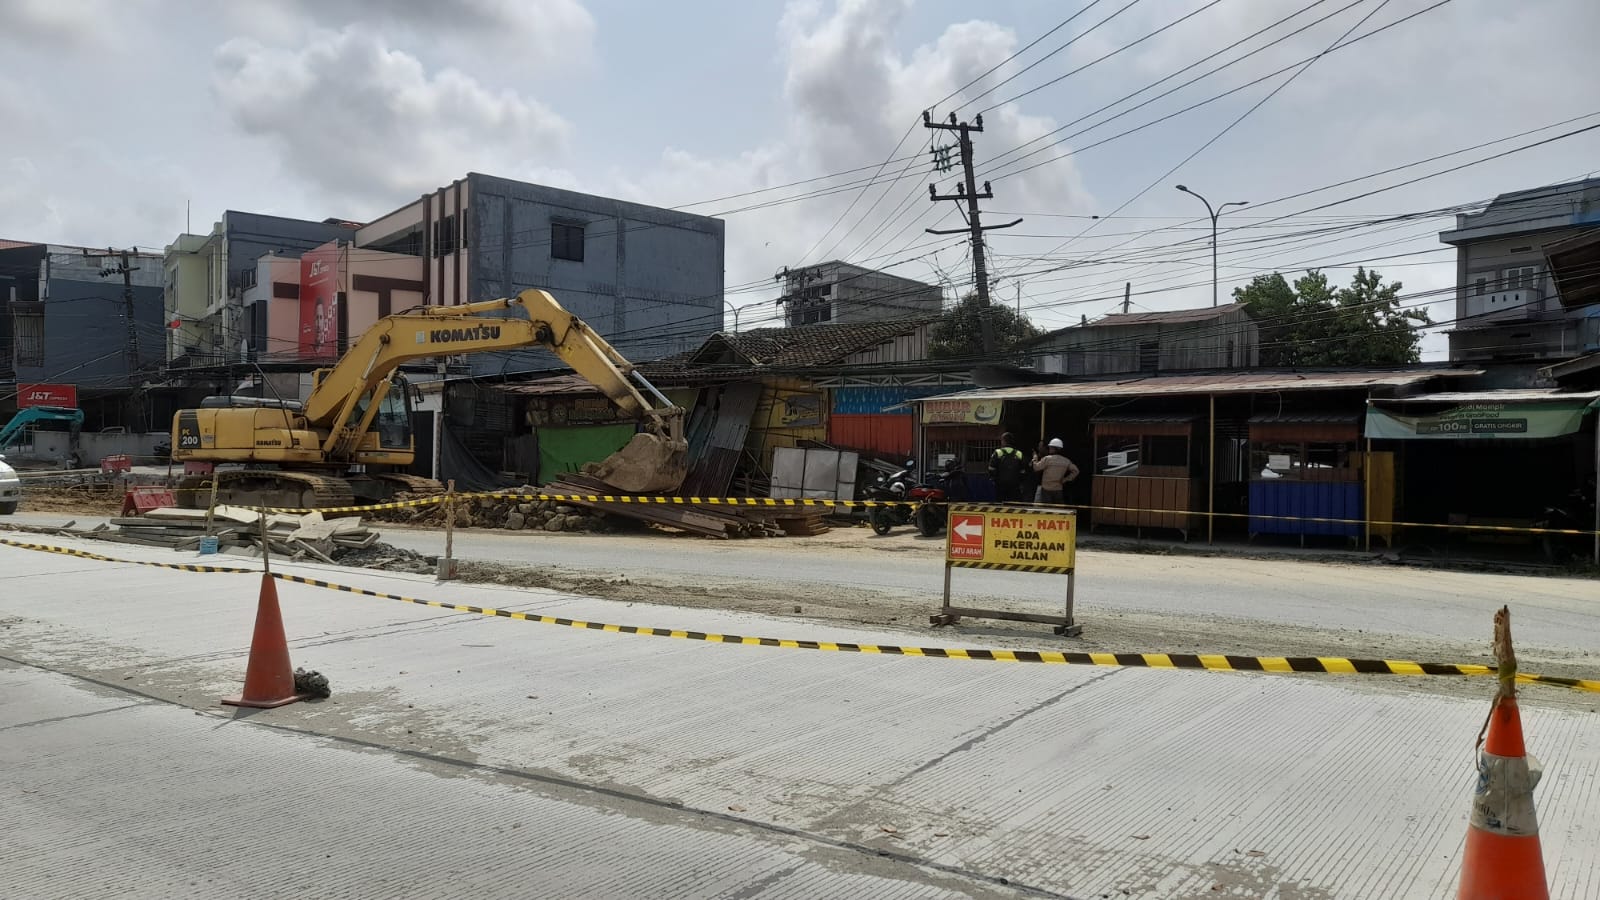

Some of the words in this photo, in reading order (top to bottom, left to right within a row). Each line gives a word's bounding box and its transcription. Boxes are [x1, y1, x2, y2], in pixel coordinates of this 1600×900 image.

[430, 323, 500, 343] KOMATSU
[27, 391, 52, 401] J&T
[181, 436, 198, 446] 200
[991, 518, 1023, 529] HATI
[1036, 519, 1071, 530] HATI
[1016, 531, 1040, 540] ADA
[994, 540, 1065, 551] PEKERJAAN
[951, 546, 966, 555] SATU
[966, 548, 982, 556] ARAH
[1009, 551, 1048, 561] JALAN
